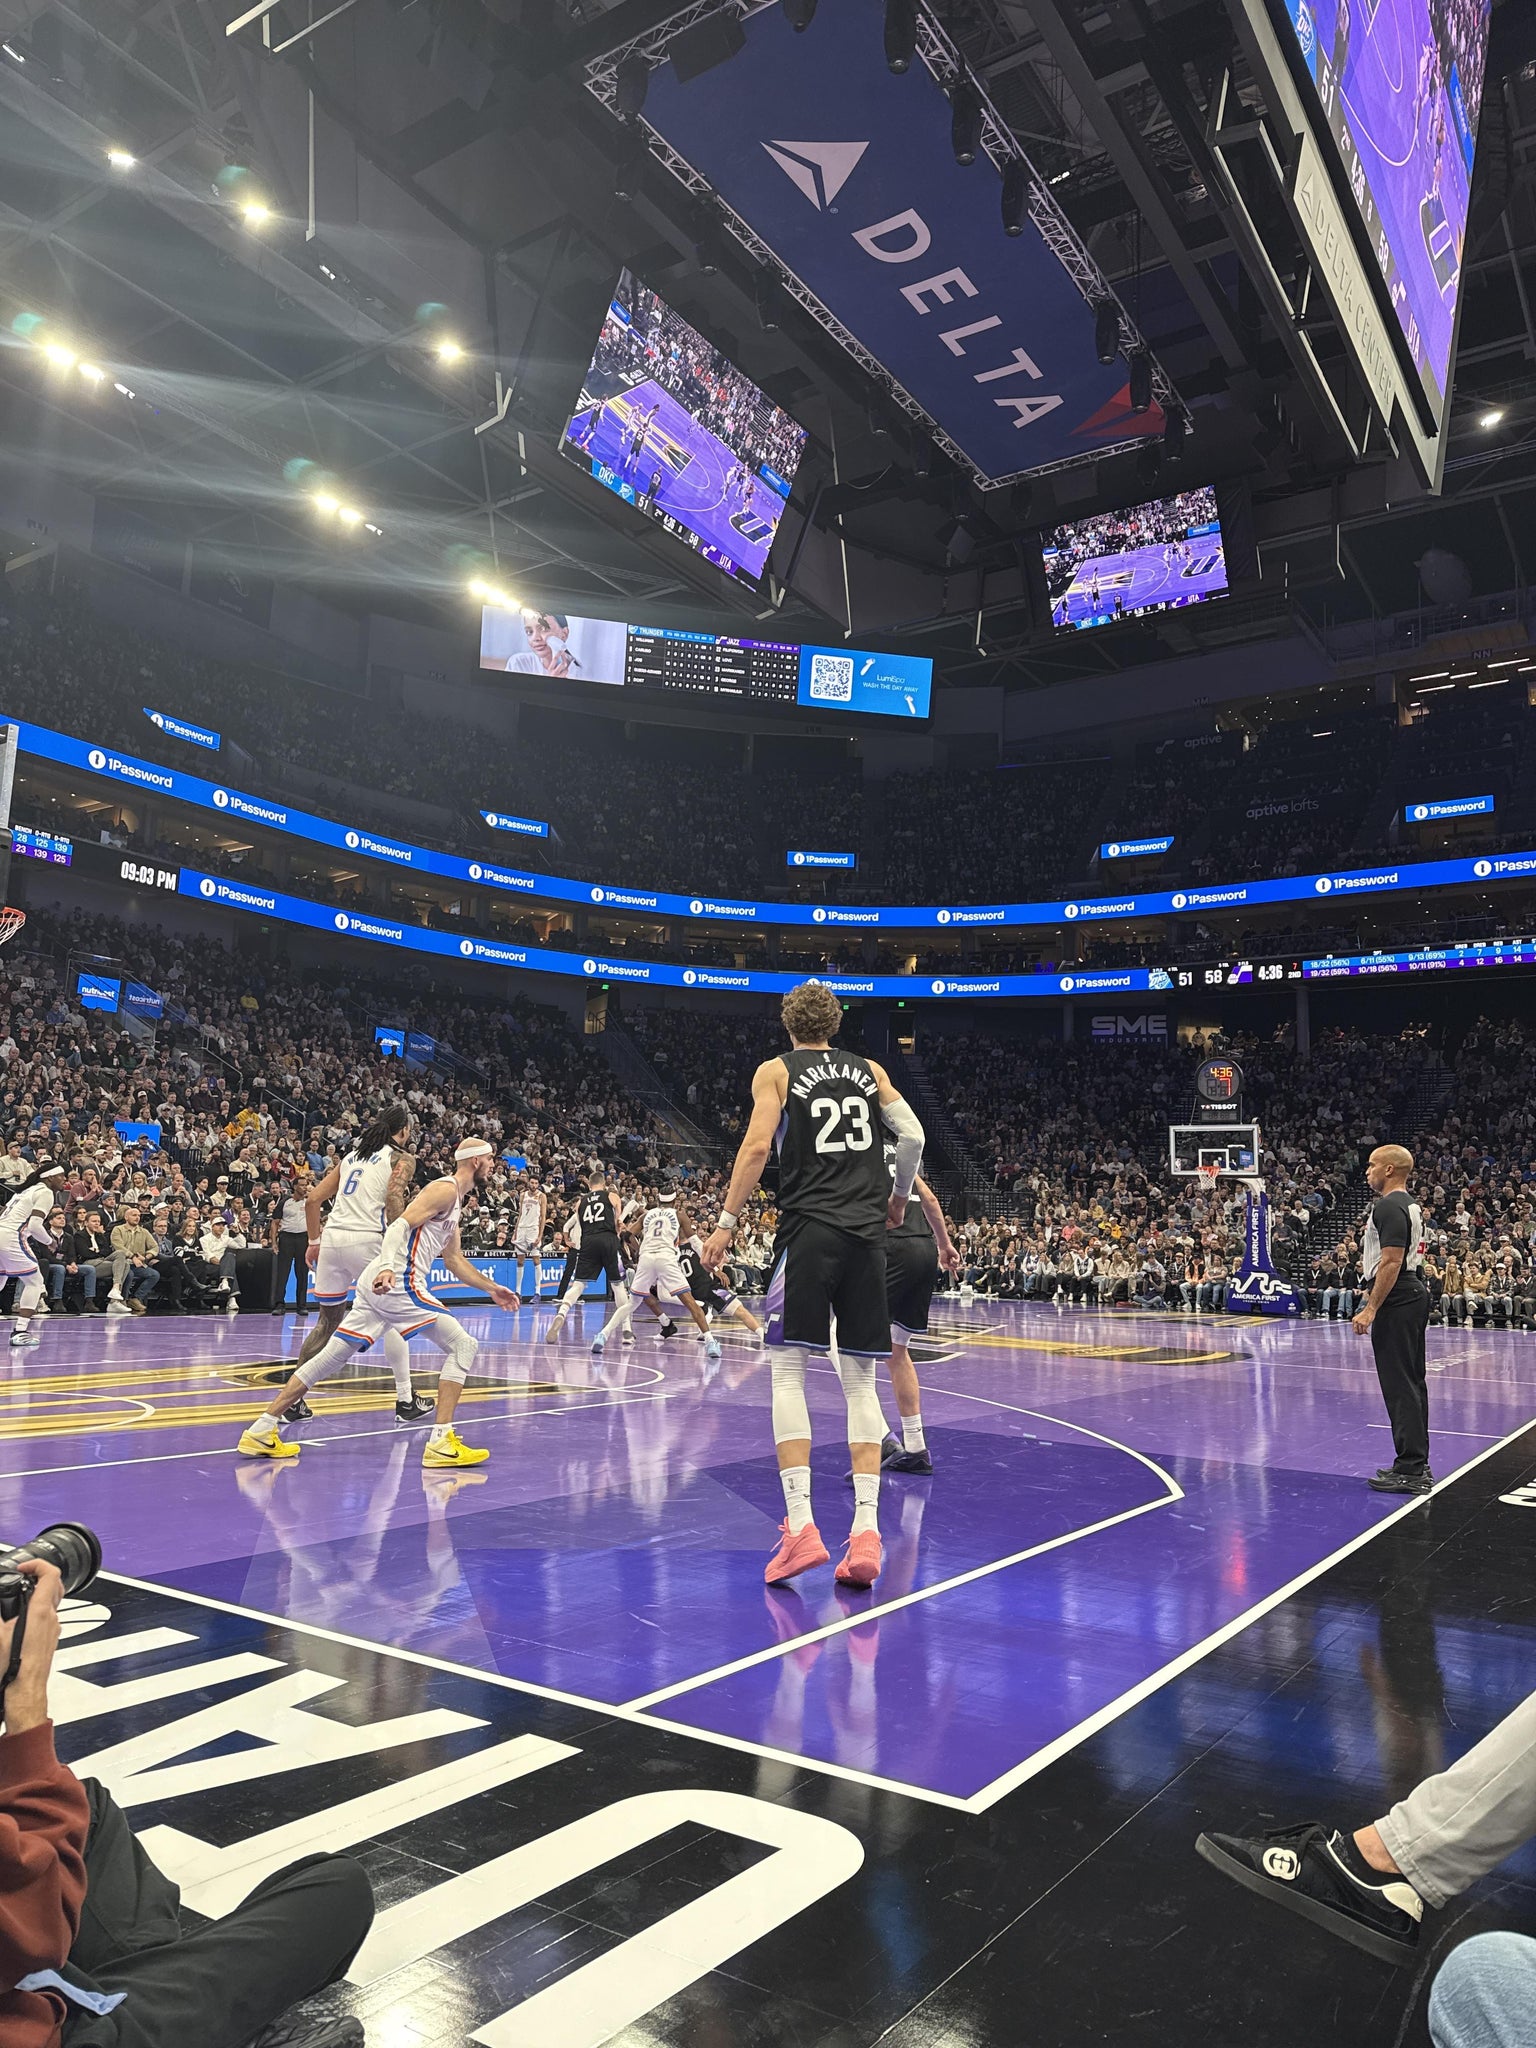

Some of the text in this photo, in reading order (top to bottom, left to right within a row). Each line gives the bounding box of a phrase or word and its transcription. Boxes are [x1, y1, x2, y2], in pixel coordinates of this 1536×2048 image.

[1321, 65, 1334, 117] 51
[1378, 230, 1389, 273] 58
[1408, 312, 1420, 362] UTA
[1315, 199, 1392, 405] DELTA CENTER
[851, 208, 1064, 429] DELTA
[598, 467, 614, 484] OKC
[638, 495, 649, 510] 51
[688, 532, 699, 545] 58
[719, 553, 732, 570] UTA
[639, 627, 664, 637] THUNDER
[726, 638, 739, 646] JAZZ
[903, 685, 919, 693] AWAY
[165, 721, 213, 744] 1Password
[1184, 734, 1222, 749] aptive
[109, 759, 172, 788] 1Password
[231, 797, 286, 823] 1Password
[1246, 799, 1319, 820] aptive lofts
[1430, 801, 1485, 815] 1Password
[499, 818, 541, 832] 1Password
[16, 833, 67, 853] 28 125 139
[358, 838, 411, 860] 1Password
[1119, 841, 1166, 852] 1Password
[15, 844, 66, 863] 23 139 125
[120, 861, 177, 891] 09:03 PM
[484, 870, 533, 887] 1Password
[1334, 873, 1397, 888] 1Password
[218, 886, 274, 909] 1Password
[606, 892, 656, 906] 1Password
[1188, 890, 1246, 904] 1Password
[702, 904, 755, 915] 1Password
[952, 911, 1004, 921] 1Password
[1080, 902, 1134, 914] 1Password
[828, 912, 878, 921] 1Password
[351, 919, 401, 939] 1Password
[475, 945, 525, 961] 1Password
[1513, 945, 1521, 953] 14
[1476, 957, 1484, 965] 12
[1494, 956, 1503, 964] 16
[1513, 954, 1522, 963] 14
[598, 964, 649, 977] 1Password
[1205, 970, 1223, 984] 58
[1258, 965, 1283, 980] 4:36
[698, 974, 749, 985] 1Password
[947, 983, 999, 991] 1Password
[1076, 976, 1130, 987] 1Password
[1179, 972, 1193, 986] 51
[1091, 1014, 1167, 1035] SME
[1210, 1067, 1233, 1078] 4:36
[791, 1064, 878, 1099] MARKKANEN
[1219, 1077, 1231, 1096] 7
[811, 1096, 873, 1153] 23
[343, 1169, 363, 1196] 6
[583, 1203, 605, 1223] 42
[653, 1220, 664, 1237] 2
